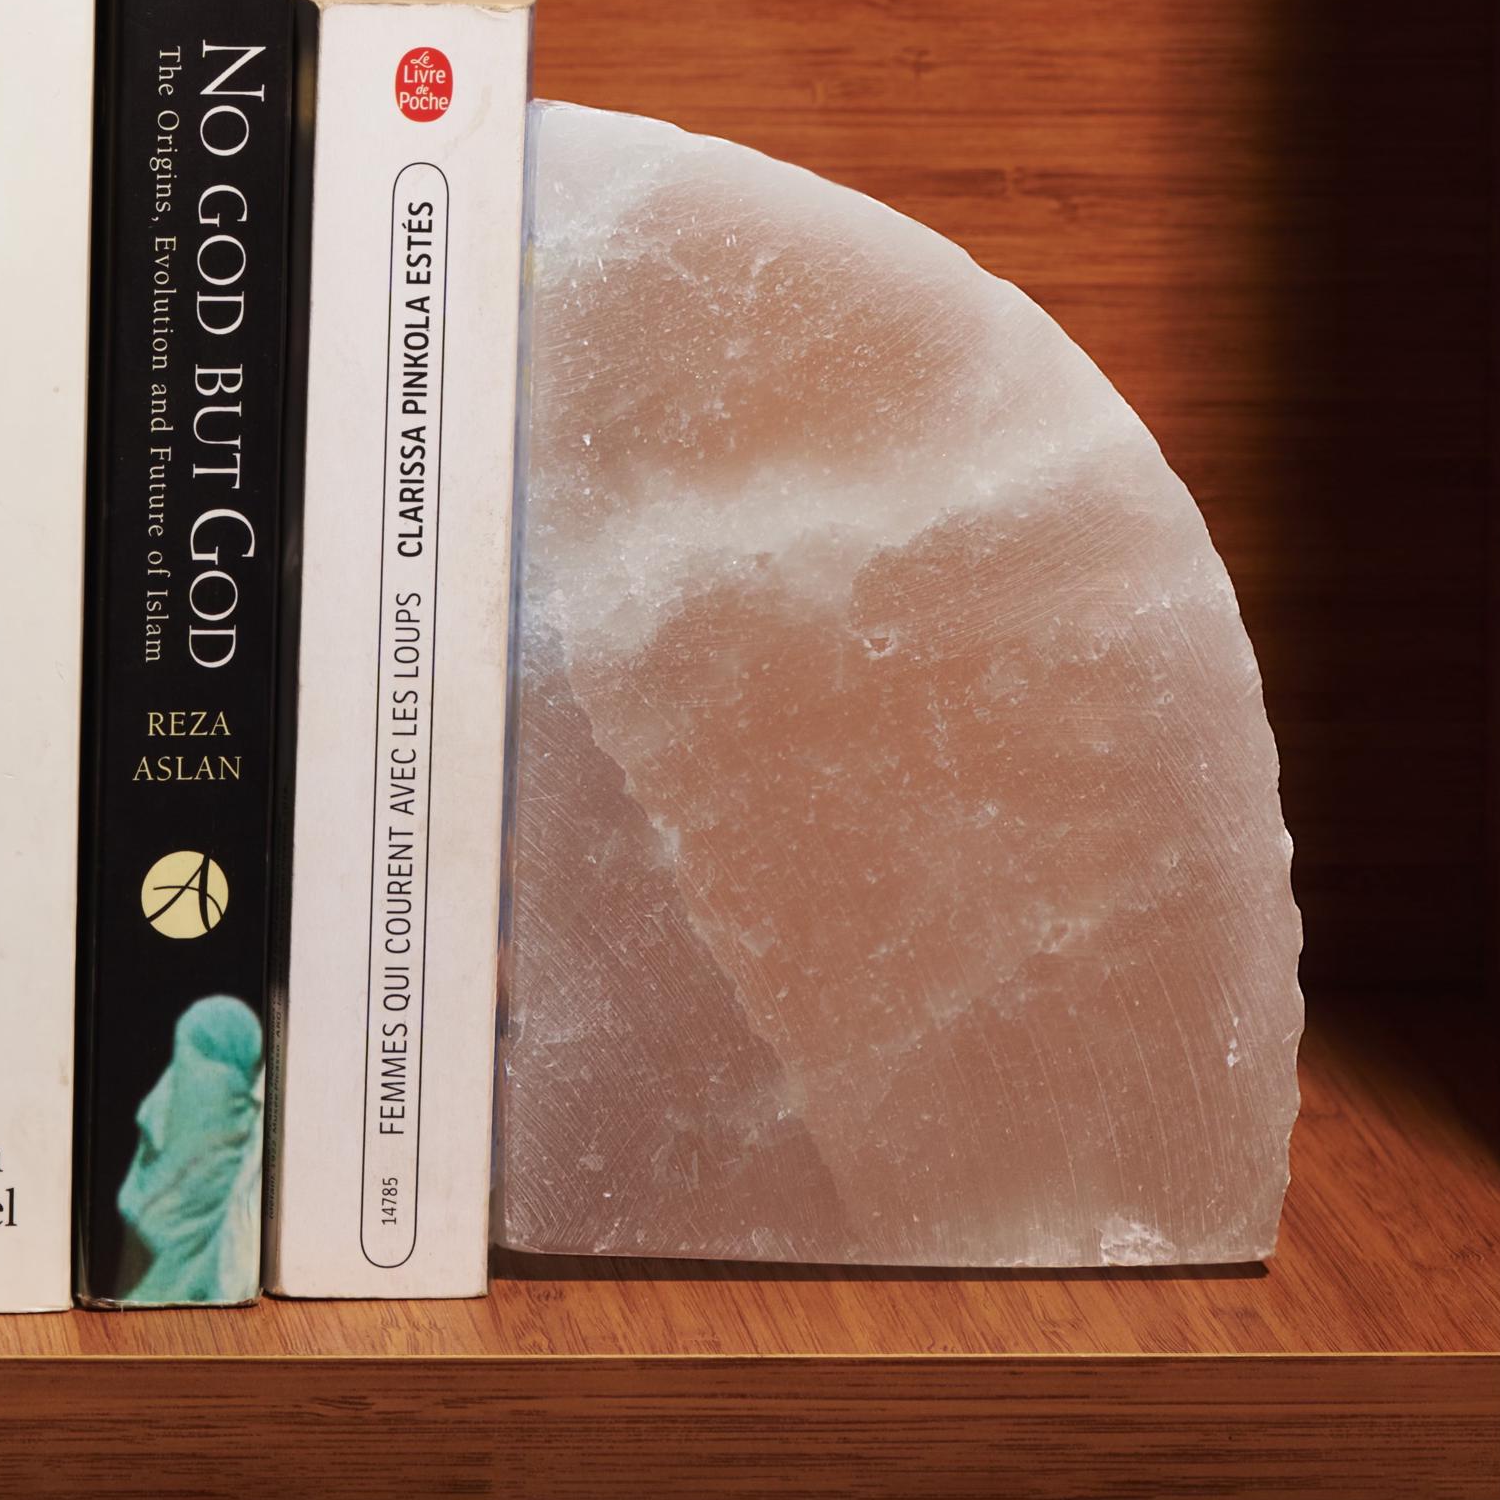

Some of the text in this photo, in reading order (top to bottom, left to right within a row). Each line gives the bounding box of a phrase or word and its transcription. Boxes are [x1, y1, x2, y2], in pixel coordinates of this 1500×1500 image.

[410, 51, 434, 68] Le
[404, 65, 446, 84] Livre
[400, 92, 449, 110] Poche
[416, 84, 429, 95] de
[146, 46, 182, 662] The Origins, Evolution and Future of Islam
[189, 40, 266, 668] NO GOD BUT GOD
[398, 202, 433, 557] CLARISSA PINKOLA ESTÉS
[148, 712, 230, 736] REZA
[133, 756, 241, 781] ASLAN
[380, 593, 421, 1134] FEMMES QUI COURENT AVEC LES LOUPS
[382, 1178, 397, 1224] 14785
